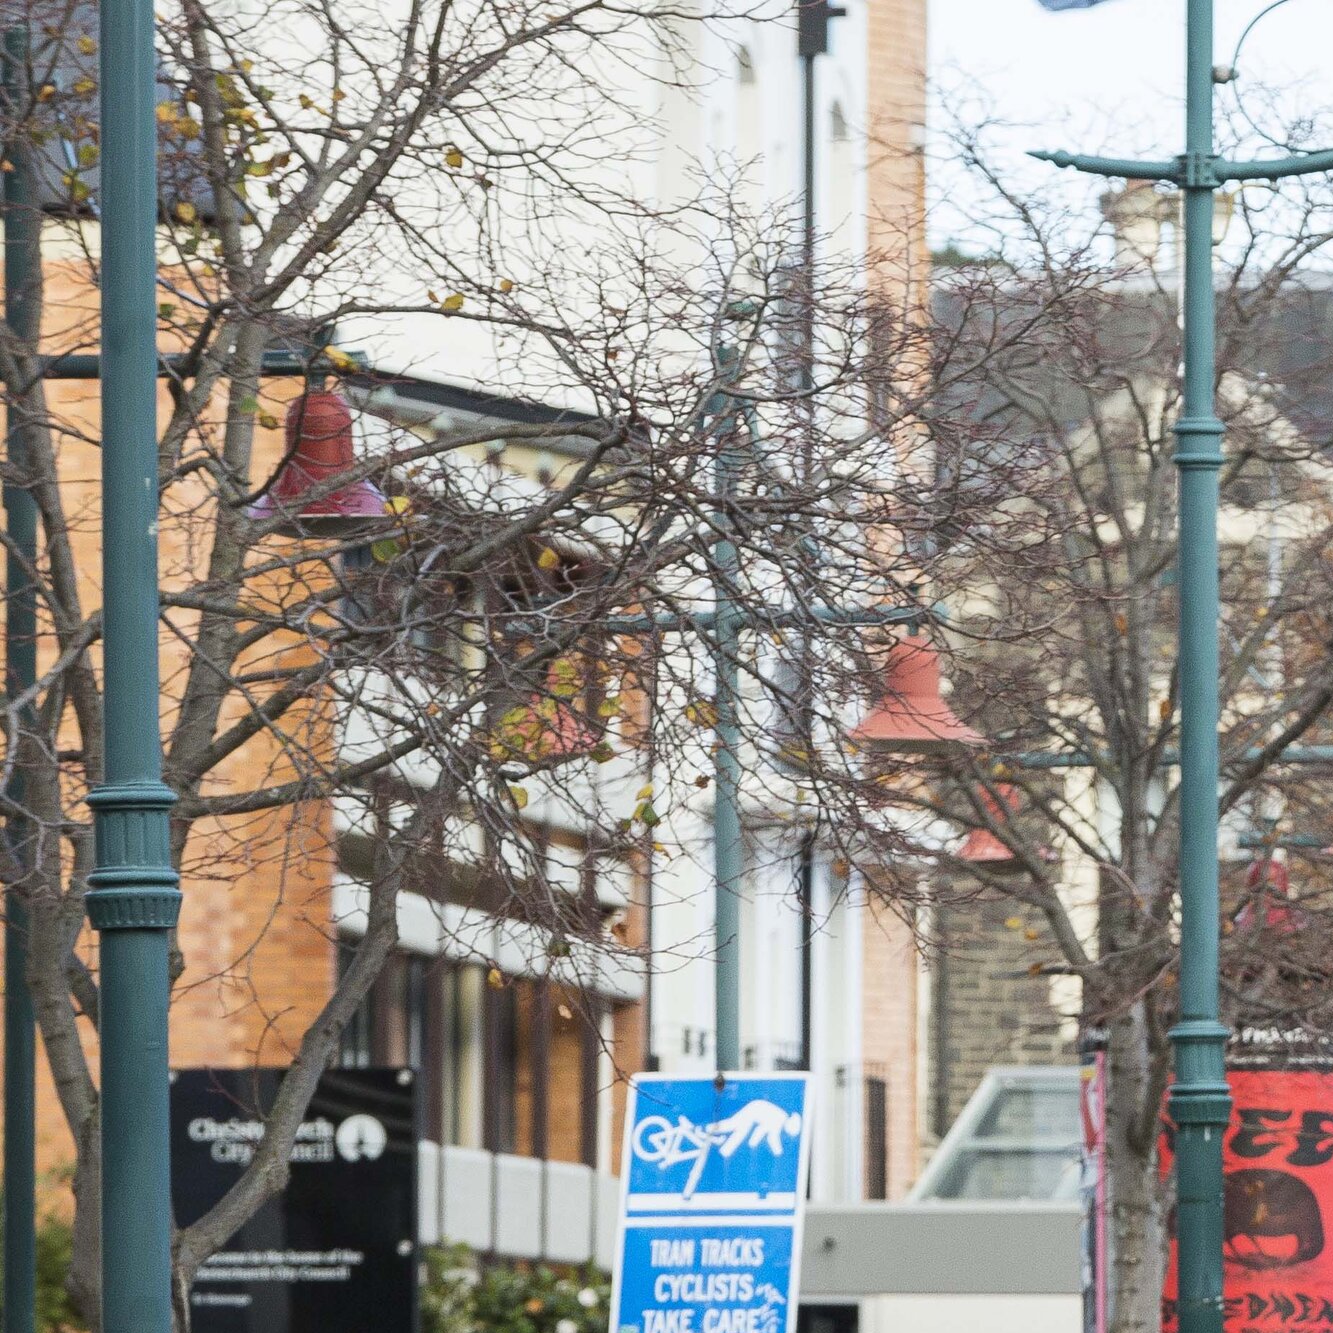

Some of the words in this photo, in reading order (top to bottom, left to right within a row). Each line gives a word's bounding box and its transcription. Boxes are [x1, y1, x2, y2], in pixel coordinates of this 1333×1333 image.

[651, 1239, 695, 1267] TRAM
[701, 1237, 764, 1267] TRACKS
[654, 1273, 755, 1303] CYCLISTS
